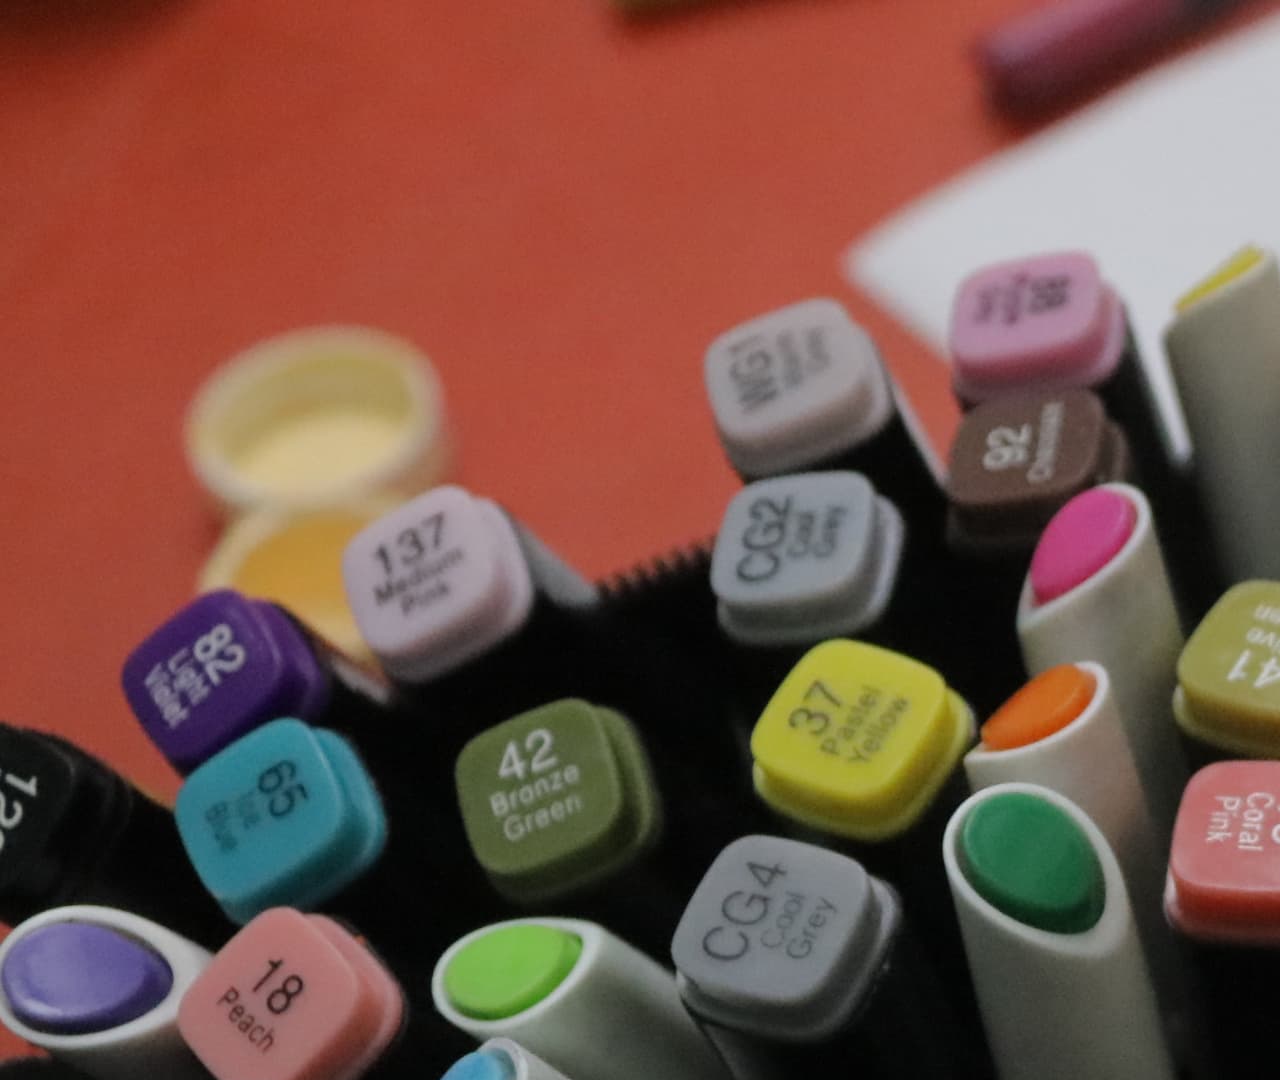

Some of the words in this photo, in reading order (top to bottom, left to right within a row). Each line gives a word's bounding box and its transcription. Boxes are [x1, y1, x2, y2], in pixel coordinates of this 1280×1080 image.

[728, 336, 779, 413] WG1
[981, 421, 1032, 473] 92
[373, 510, 446, 577] 137
[737, 494, 794, 581] CG2
[373, 546, 464, 606] Medium
[194, 622, 246, 686] 82
[788, 679, 844, 736] 37
[819, 684, 882, 757] Pastel
[848, 695, 910, 763] Yellow
[498, 727, 557, 779] 42
[0, 773, 38, 853] 12
[256, 760, 310, 821] 65
[489, 763, 581, 817] Bronze
[503, 793, 582, 842] Green
[1206, 796, 1242, 846] Pink
[1238, 792, 1275, 852] Coral
[702, 860, 788, 961] CG4
[759, 892, 805, 950] Cool
[786, 897, 838, 960] Grey
[252, 958, 305, 1015] 18
[217, 985, 276, 1055] Peach
